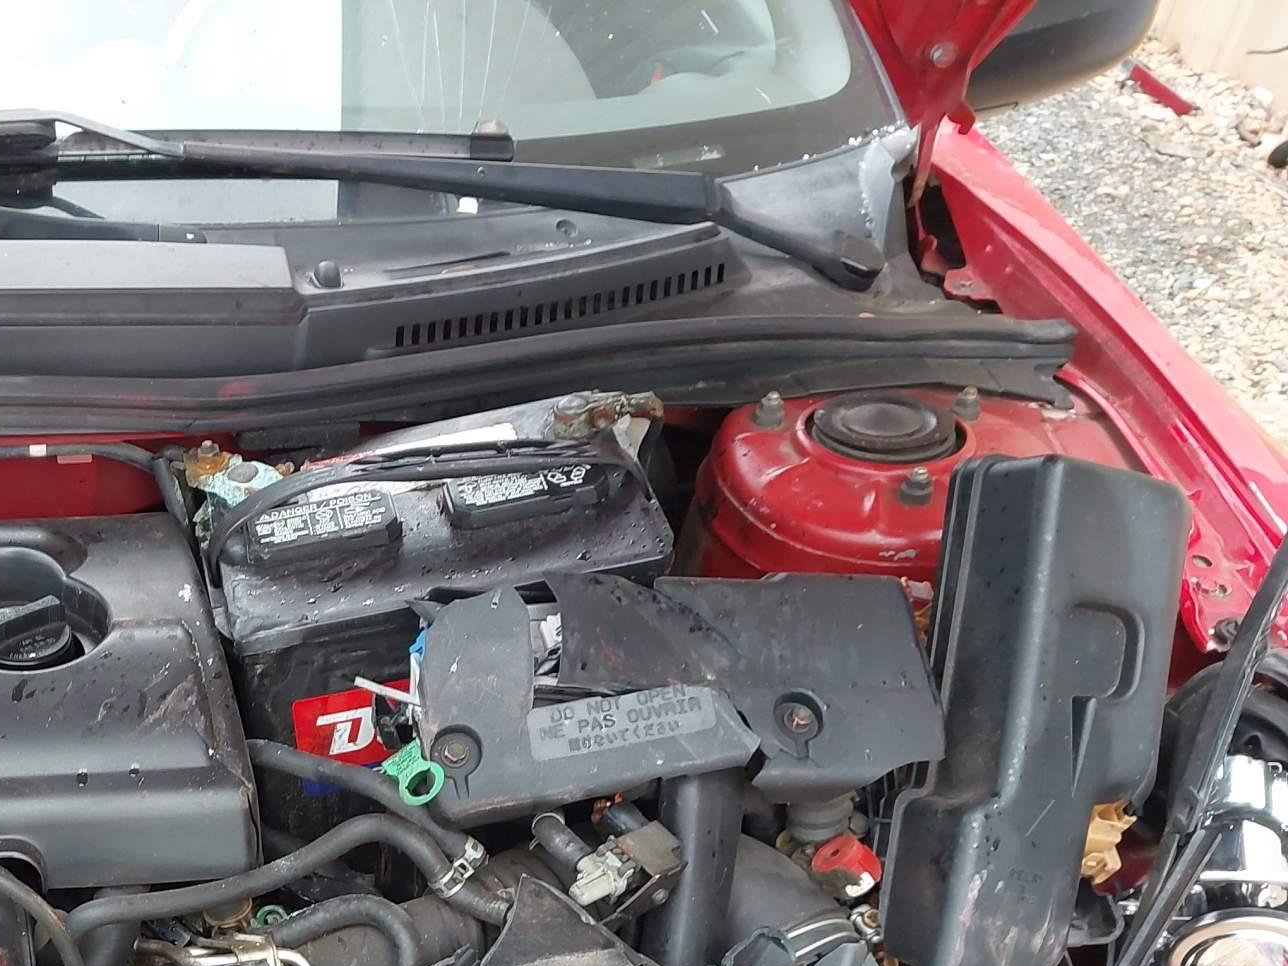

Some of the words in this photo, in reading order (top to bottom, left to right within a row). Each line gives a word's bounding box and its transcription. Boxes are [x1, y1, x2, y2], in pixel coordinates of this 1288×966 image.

[270, 503, 318, 520] DANGER
[329, 492, 372, 507] POISON
[550, 706, 575, 723] DO
[587, 698, 621, 716] NOT
[636, 684, 687, 706] OPEN
[577, 714, 617, 734] PAS
[626, 696, 703, 724] OUVRIR
